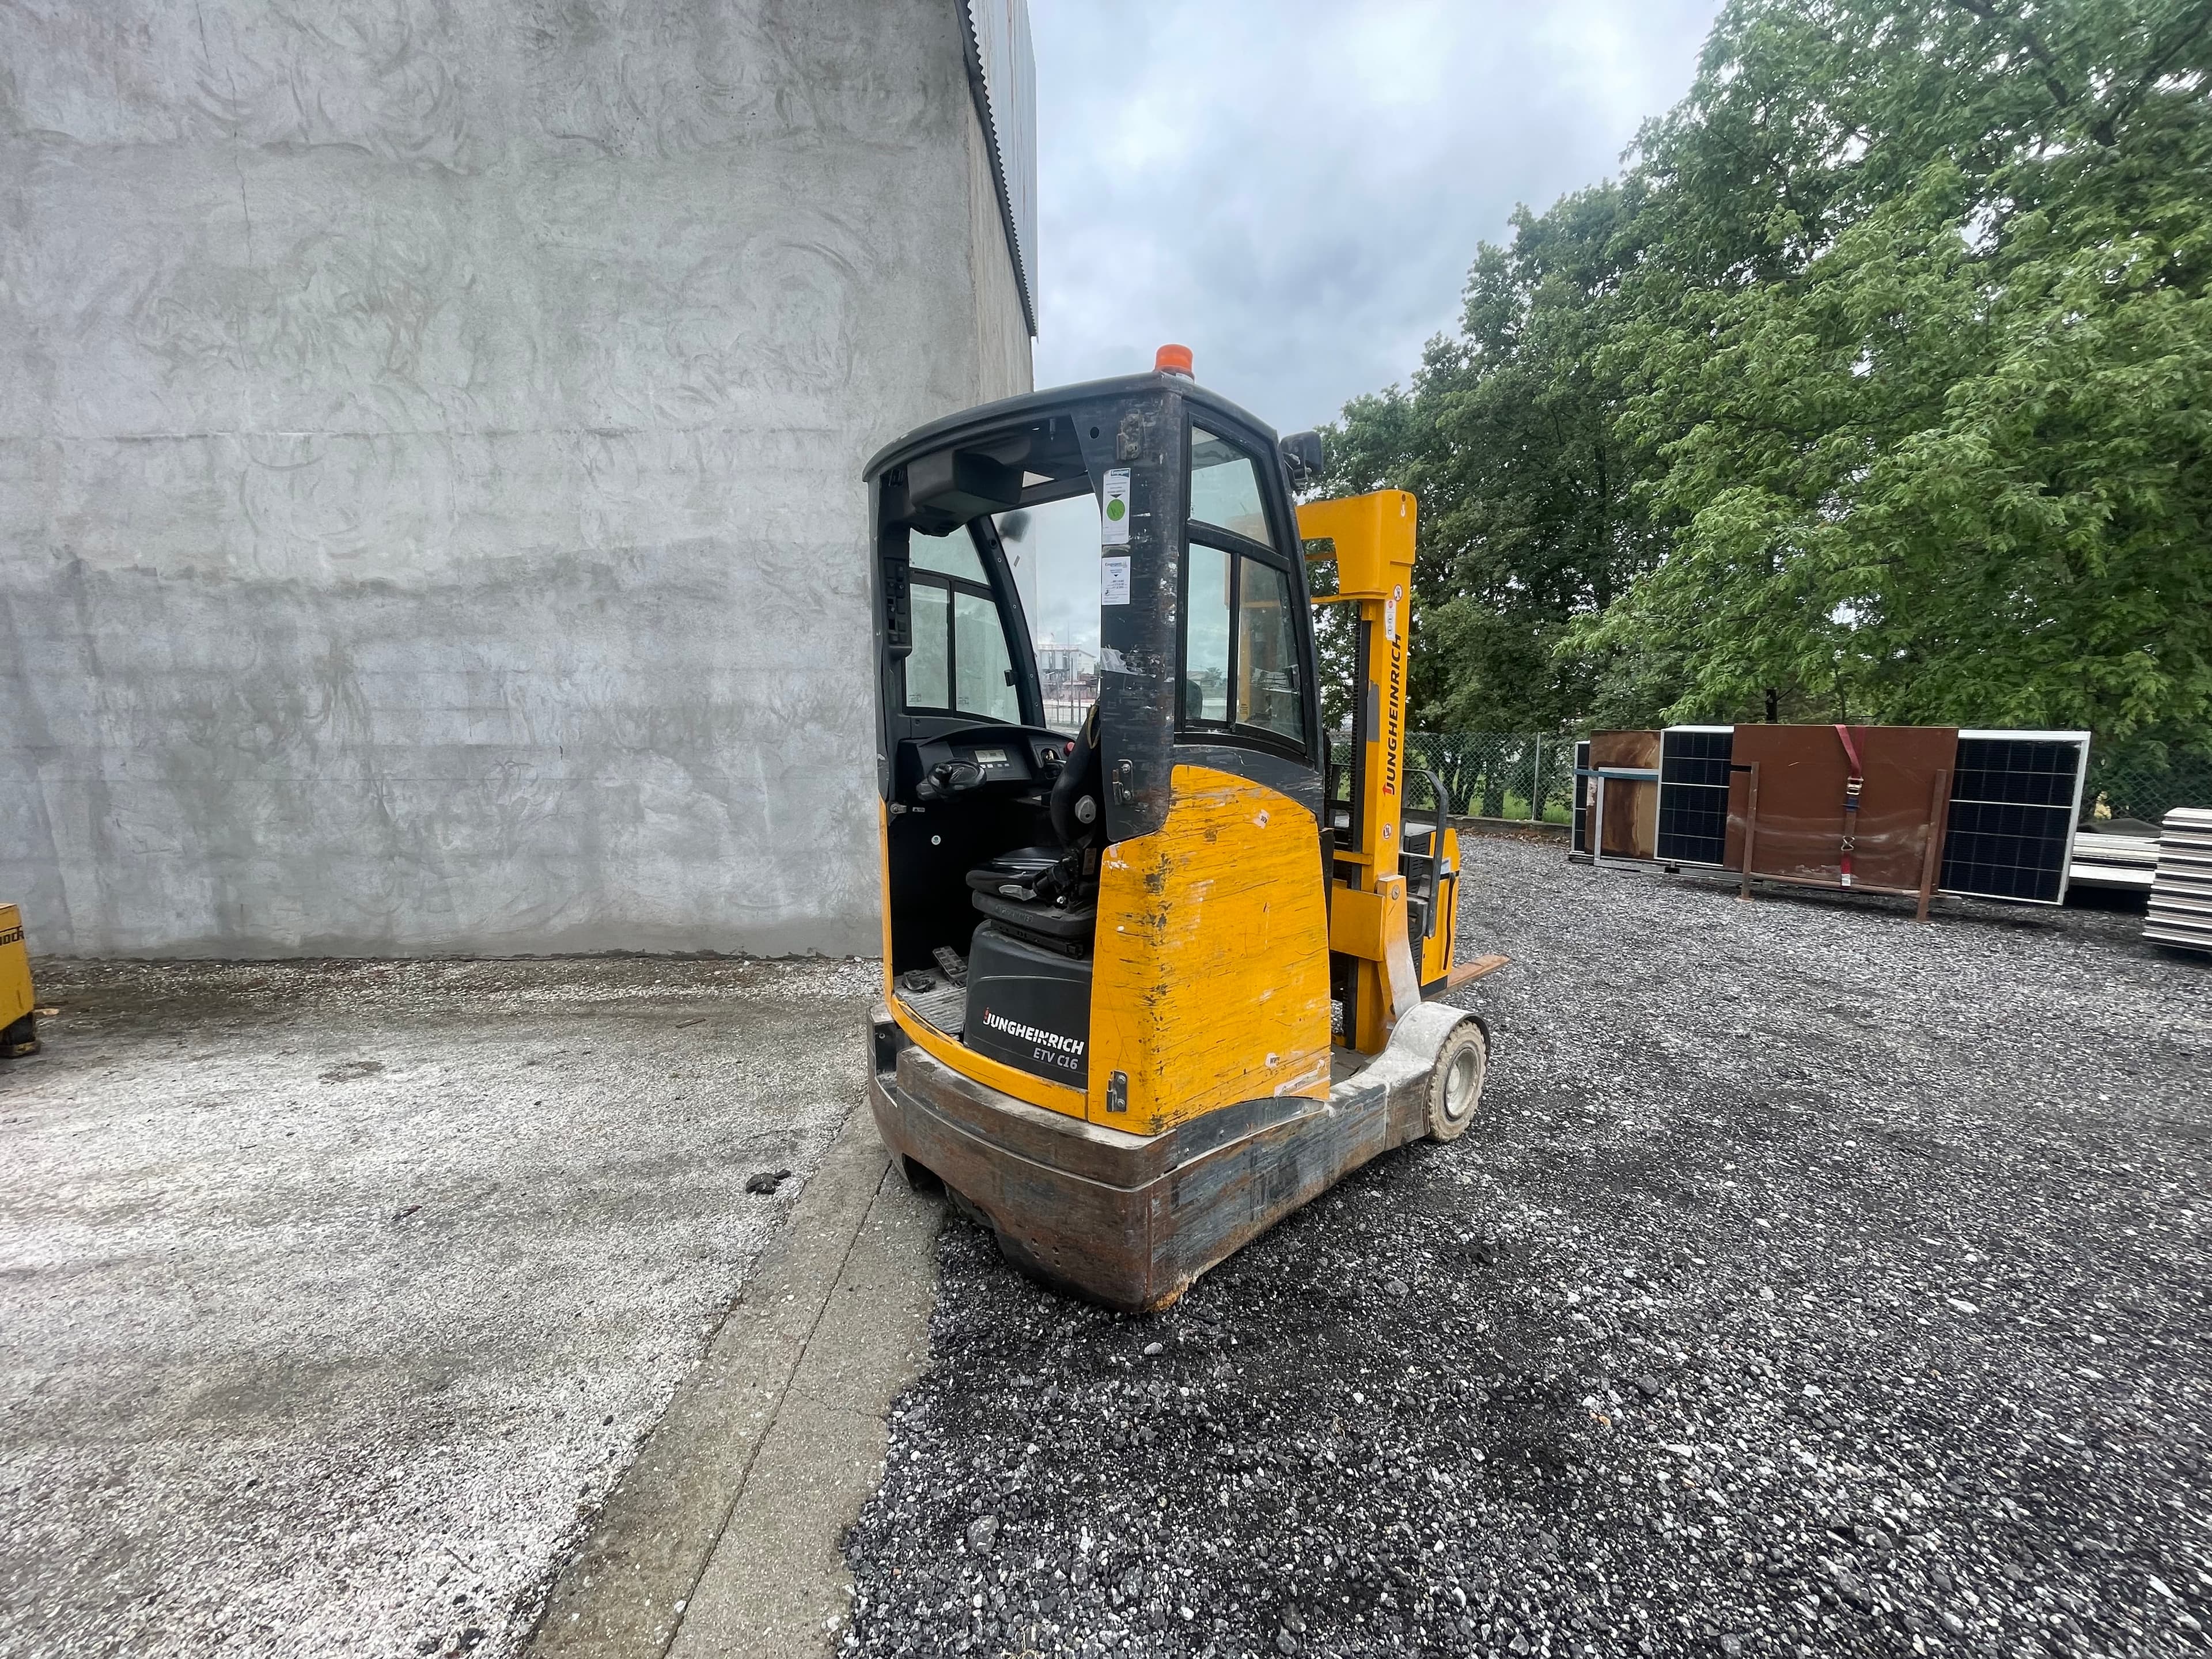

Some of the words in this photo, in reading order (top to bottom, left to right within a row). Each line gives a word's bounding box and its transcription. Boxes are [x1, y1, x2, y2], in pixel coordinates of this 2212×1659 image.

[1385, 634, 1402, 796] JUNGHEINRICH
[983, 1012, 1085, 1055] JUNGHEINRICH
[1033, 1047, 1056, 1063] ETV
[1056, 1054, 1079, 1070] C16
